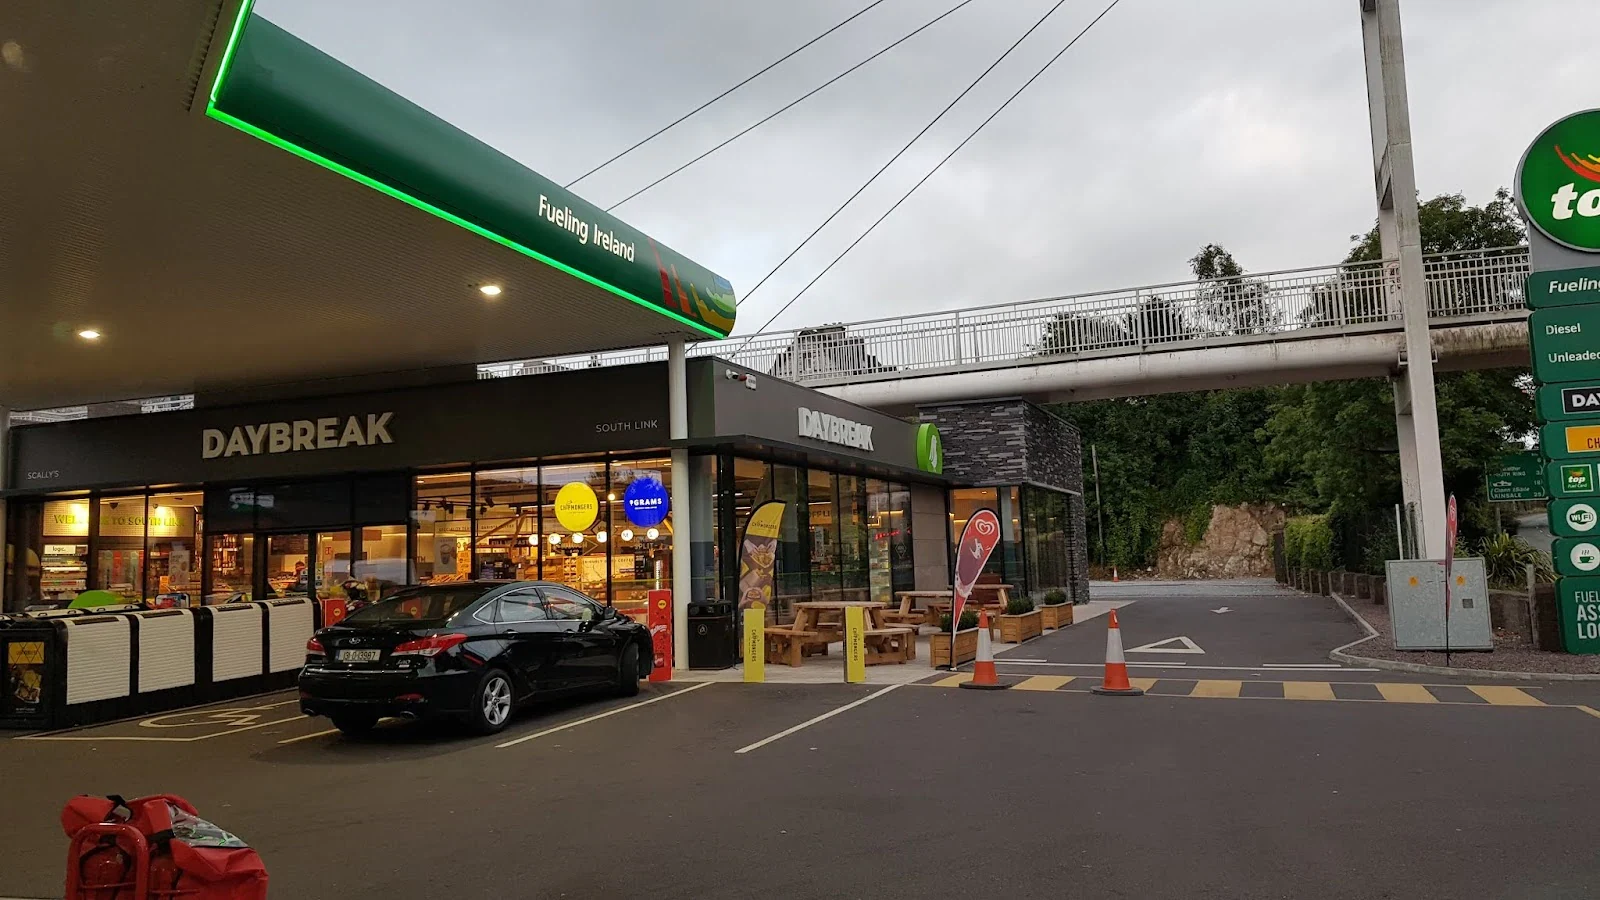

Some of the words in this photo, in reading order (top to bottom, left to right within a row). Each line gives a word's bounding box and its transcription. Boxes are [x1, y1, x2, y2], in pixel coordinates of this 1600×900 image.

[538, 193, 588, 245] Fueling
[594, 223, 635, 263] Ireland
[1549, 277, 1600, 293] Fuelin
[1546, 323, 1581, 335] Diesel
[596, 422, 631, 433] SOUTH
[635, 419, 658, 431] LINK
[798, 407, 874, 451] DAYBREAK
[202, 411, 393, 459] DAYBREAK
[27, 470, 59, 480] SCALLY'S
[1568, 475, 1586, 484] top
[1577, 604, 1600, 621] AS
[1577, 622, 1600, 639] LO
